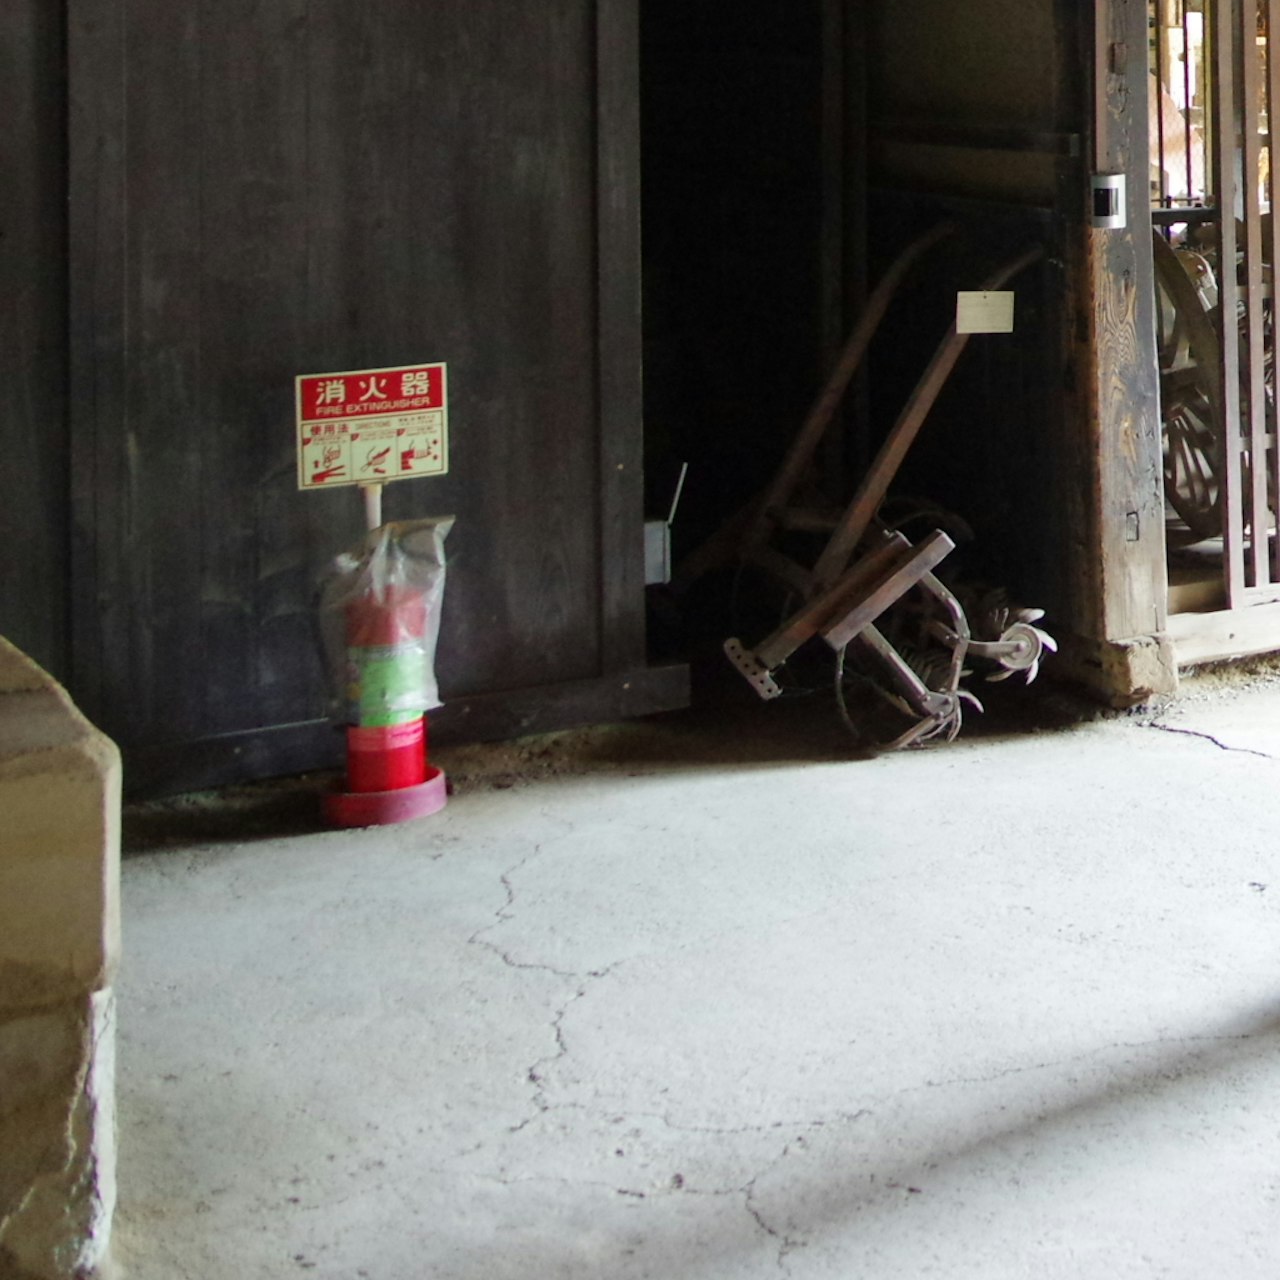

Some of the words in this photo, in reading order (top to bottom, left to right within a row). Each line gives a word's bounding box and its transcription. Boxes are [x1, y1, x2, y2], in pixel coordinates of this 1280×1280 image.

[315, 371, 430, 405] 消火器
[315, 405, 346, 416] FIRE
[346, 396, 431, 413] EXTINGUISHER
[310, 422, 349, 436] 使用法
